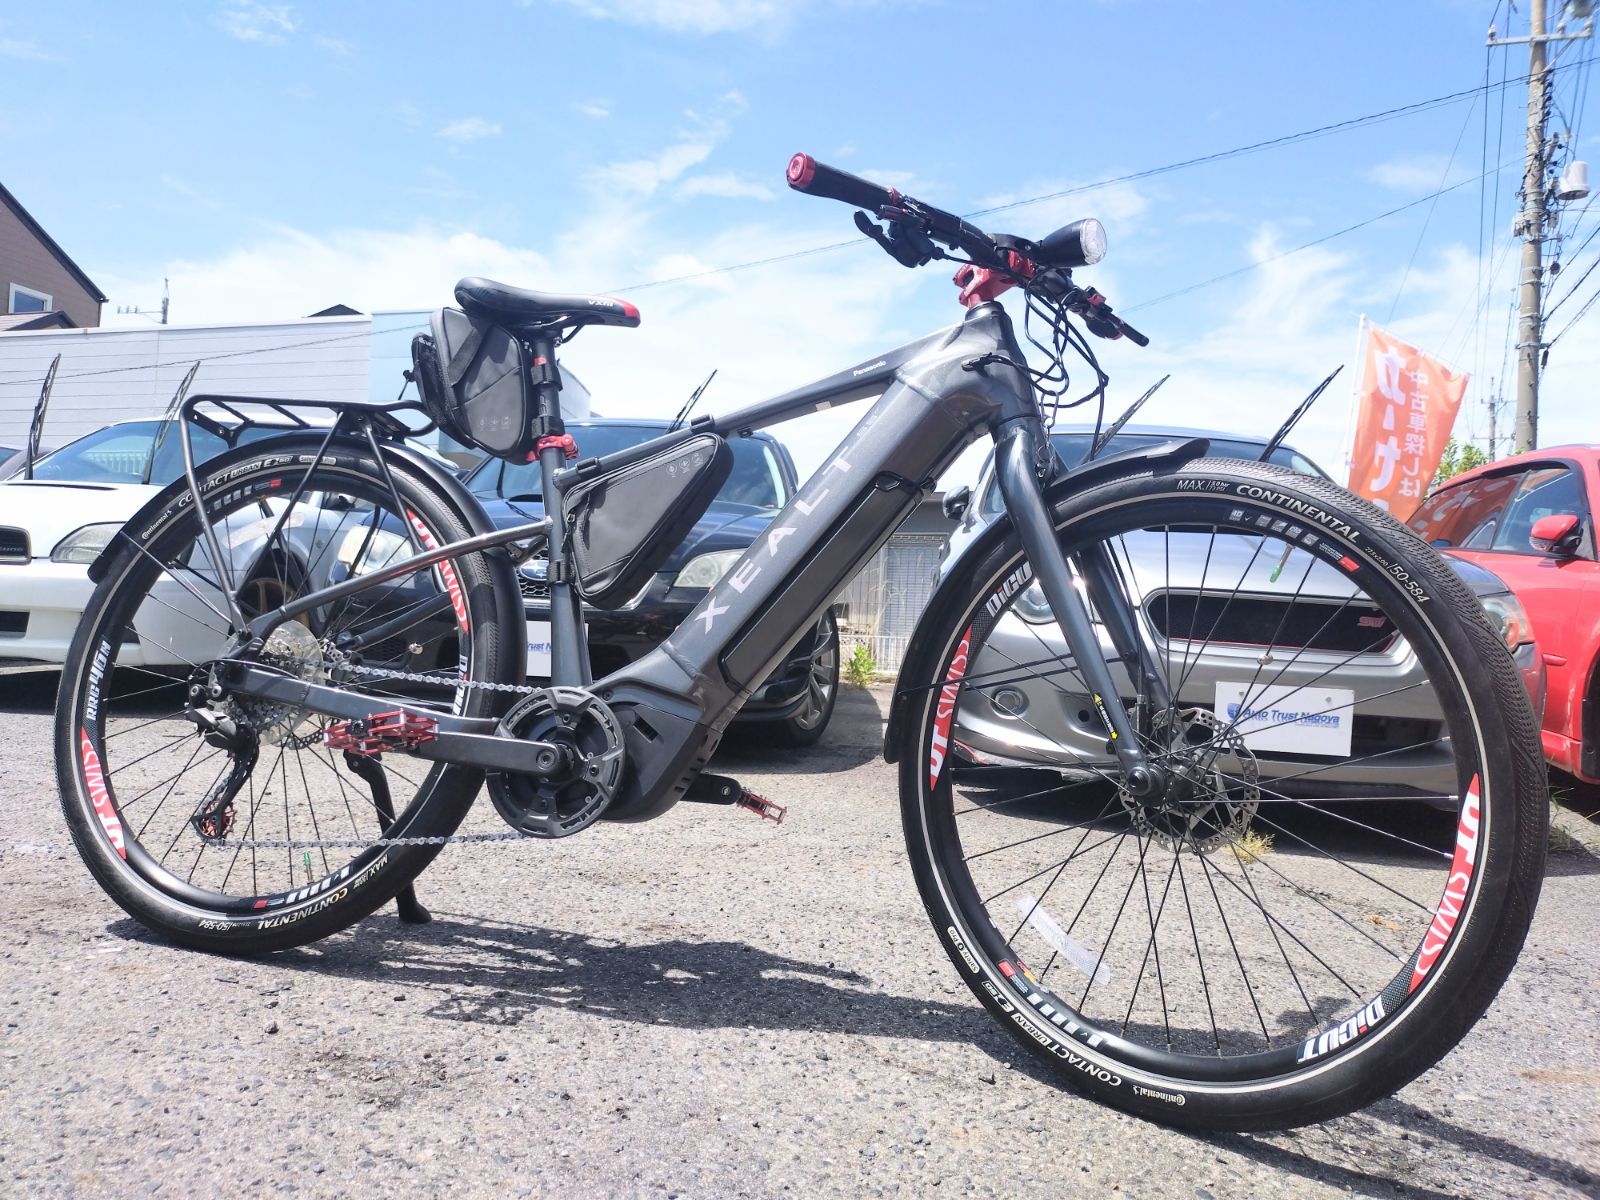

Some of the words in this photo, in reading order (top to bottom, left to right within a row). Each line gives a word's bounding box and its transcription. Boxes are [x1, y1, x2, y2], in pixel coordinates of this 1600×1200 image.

[853, 360, 886, 377] Panasonic
[1236, 484, 1360, 544] CONTINENTAL
[694, 446, 852, 635] XEALT
[527, 642, 544, 650] rust
[936, 639, 970, 719] SWISS
[1271, 709, 1298, 721] Trust
[1300, 711, 1341, 725] Nagoya
[81, 739, 109, 808] SWISS
[1456, 791, 1481, 866] DT
[257, 887, 348, 930] CONTINENTAL
[1415, 872, 1470, 976] SWISS
[1012, 1013, 1052, 1048] URBAN
[1048, 1044, 1123, 1088] CONTACT
[1136, 1087, 1187, 1107] Continental
